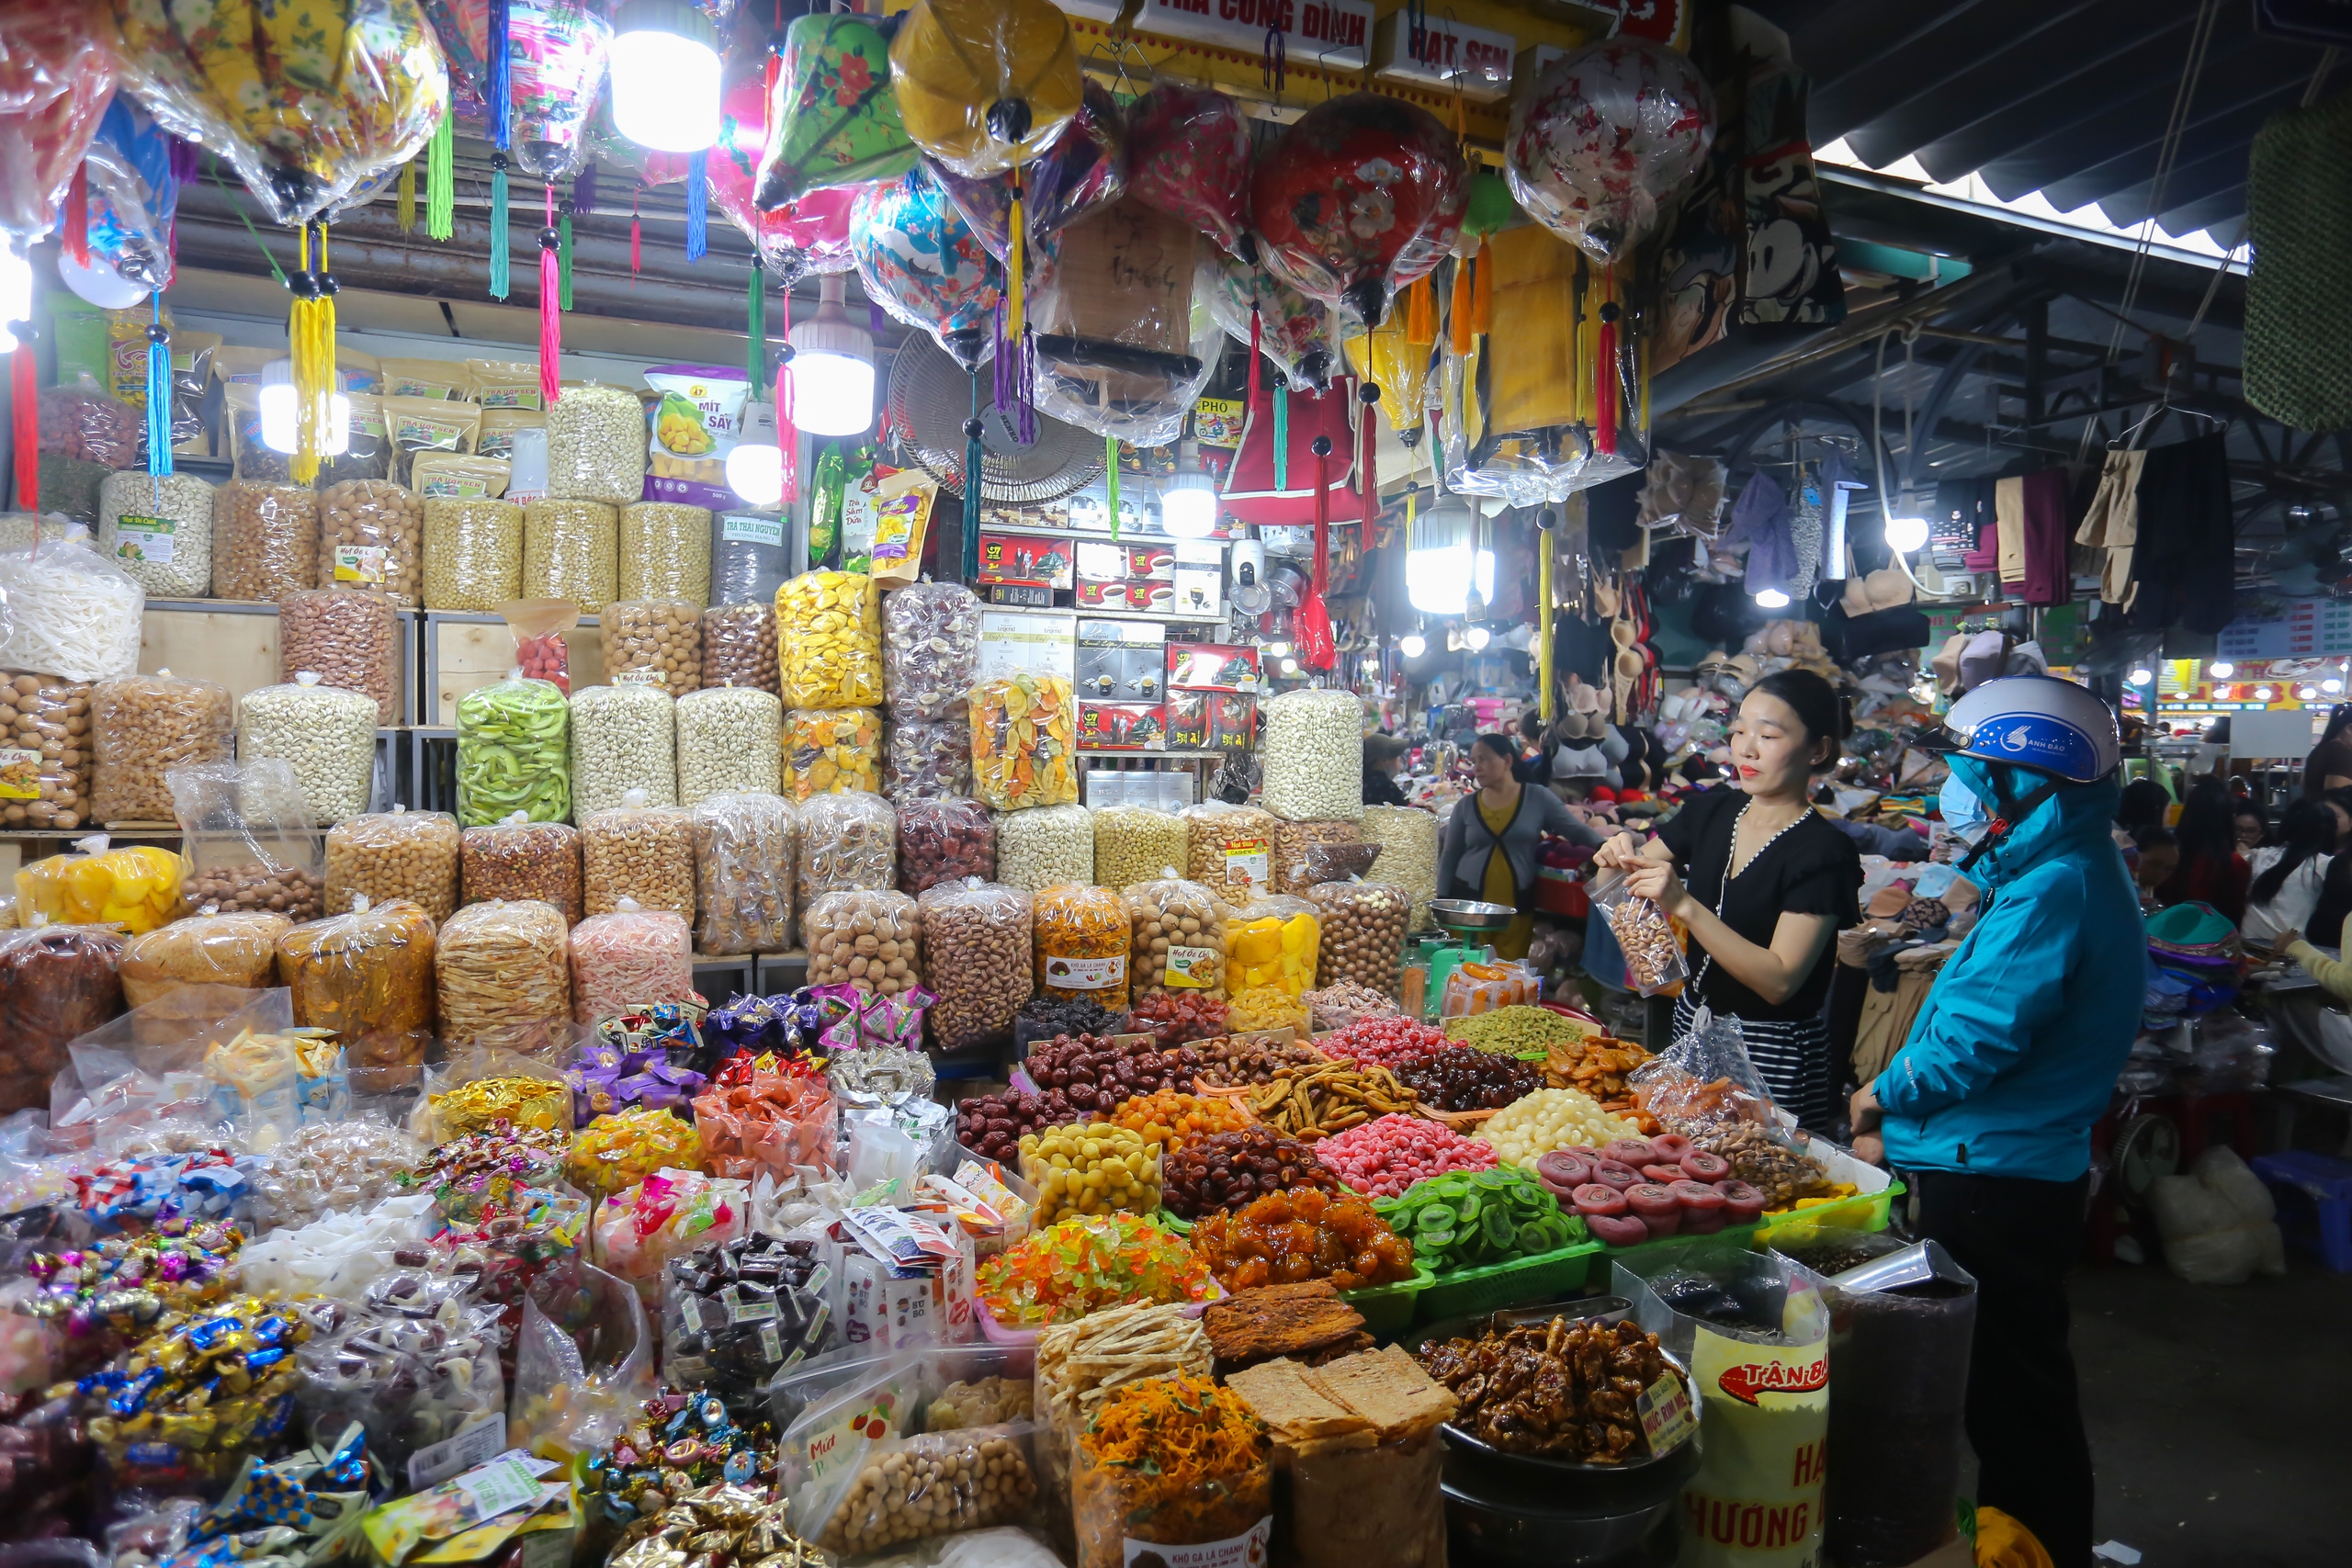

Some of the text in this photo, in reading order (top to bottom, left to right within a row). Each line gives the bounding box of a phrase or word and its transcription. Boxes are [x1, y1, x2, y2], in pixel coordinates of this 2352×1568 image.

[2028, 739, 2046, 748] ANH
[912, 1299, 925, 1310] SU
[1660, 1399, 1678, 1423] RIM
[1172, 1552, 1191, 1563] KHÔ
[1192, 1551, 1204, 1562] GÀ
[1205, 1549, 1216, 1560] LÁ
[1217, 1543, 1244, 1558] CHANH
